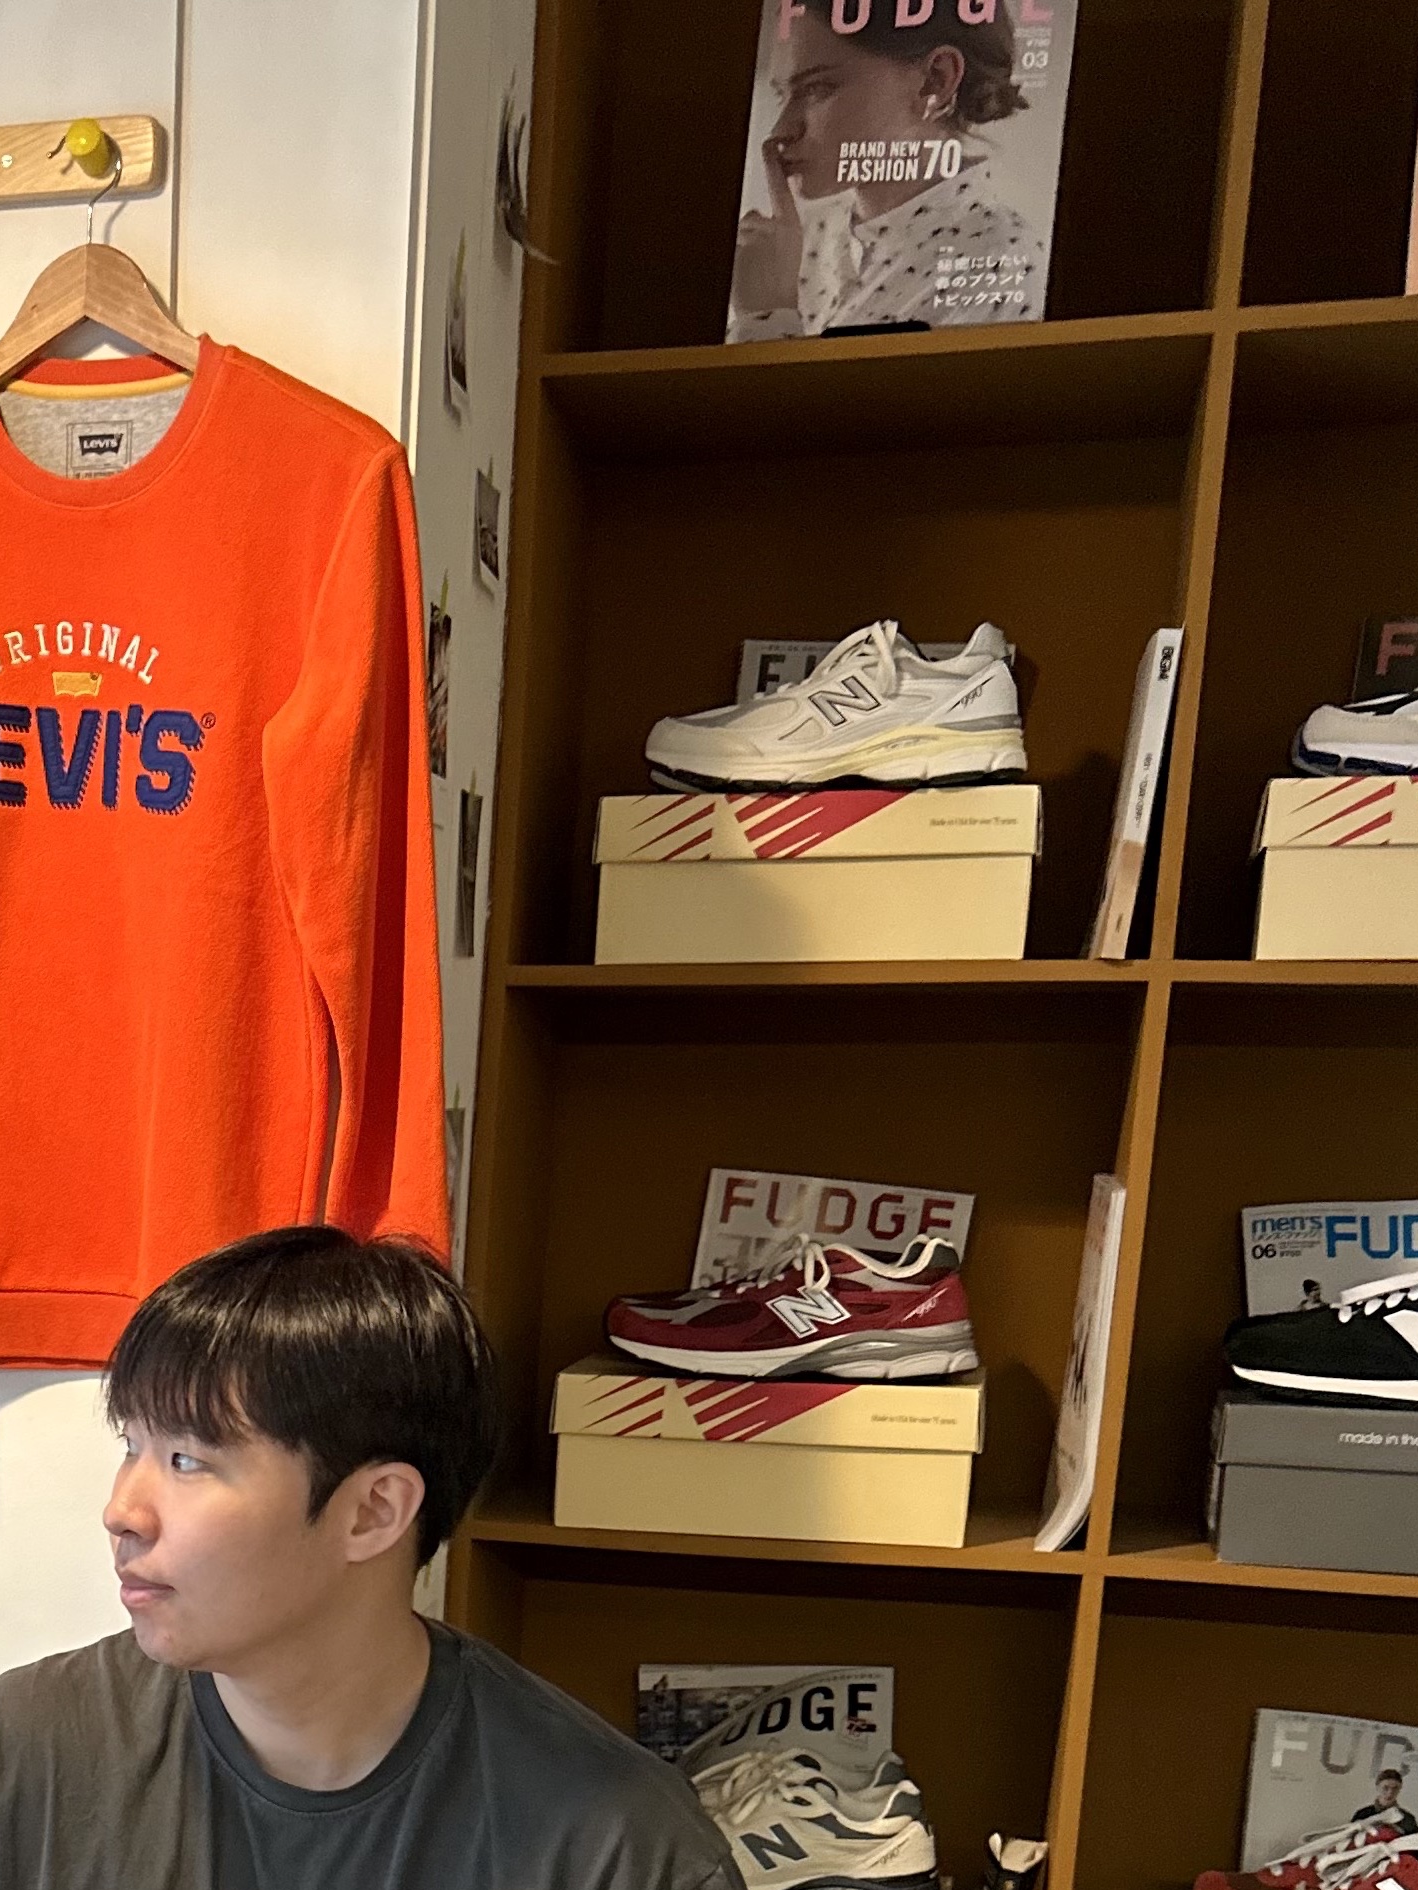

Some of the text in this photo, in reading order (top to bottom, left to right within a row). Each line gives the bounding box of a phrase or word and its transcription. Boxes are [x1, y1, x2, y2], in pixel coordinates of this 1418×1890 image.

[837, 158, 919, 183] FASHION
[839, 139, 963, 180] BRAND NEW 70
[719, 1177, 955, 1240] FUDGE
[1251, 1243, 1277, 1260] 06
